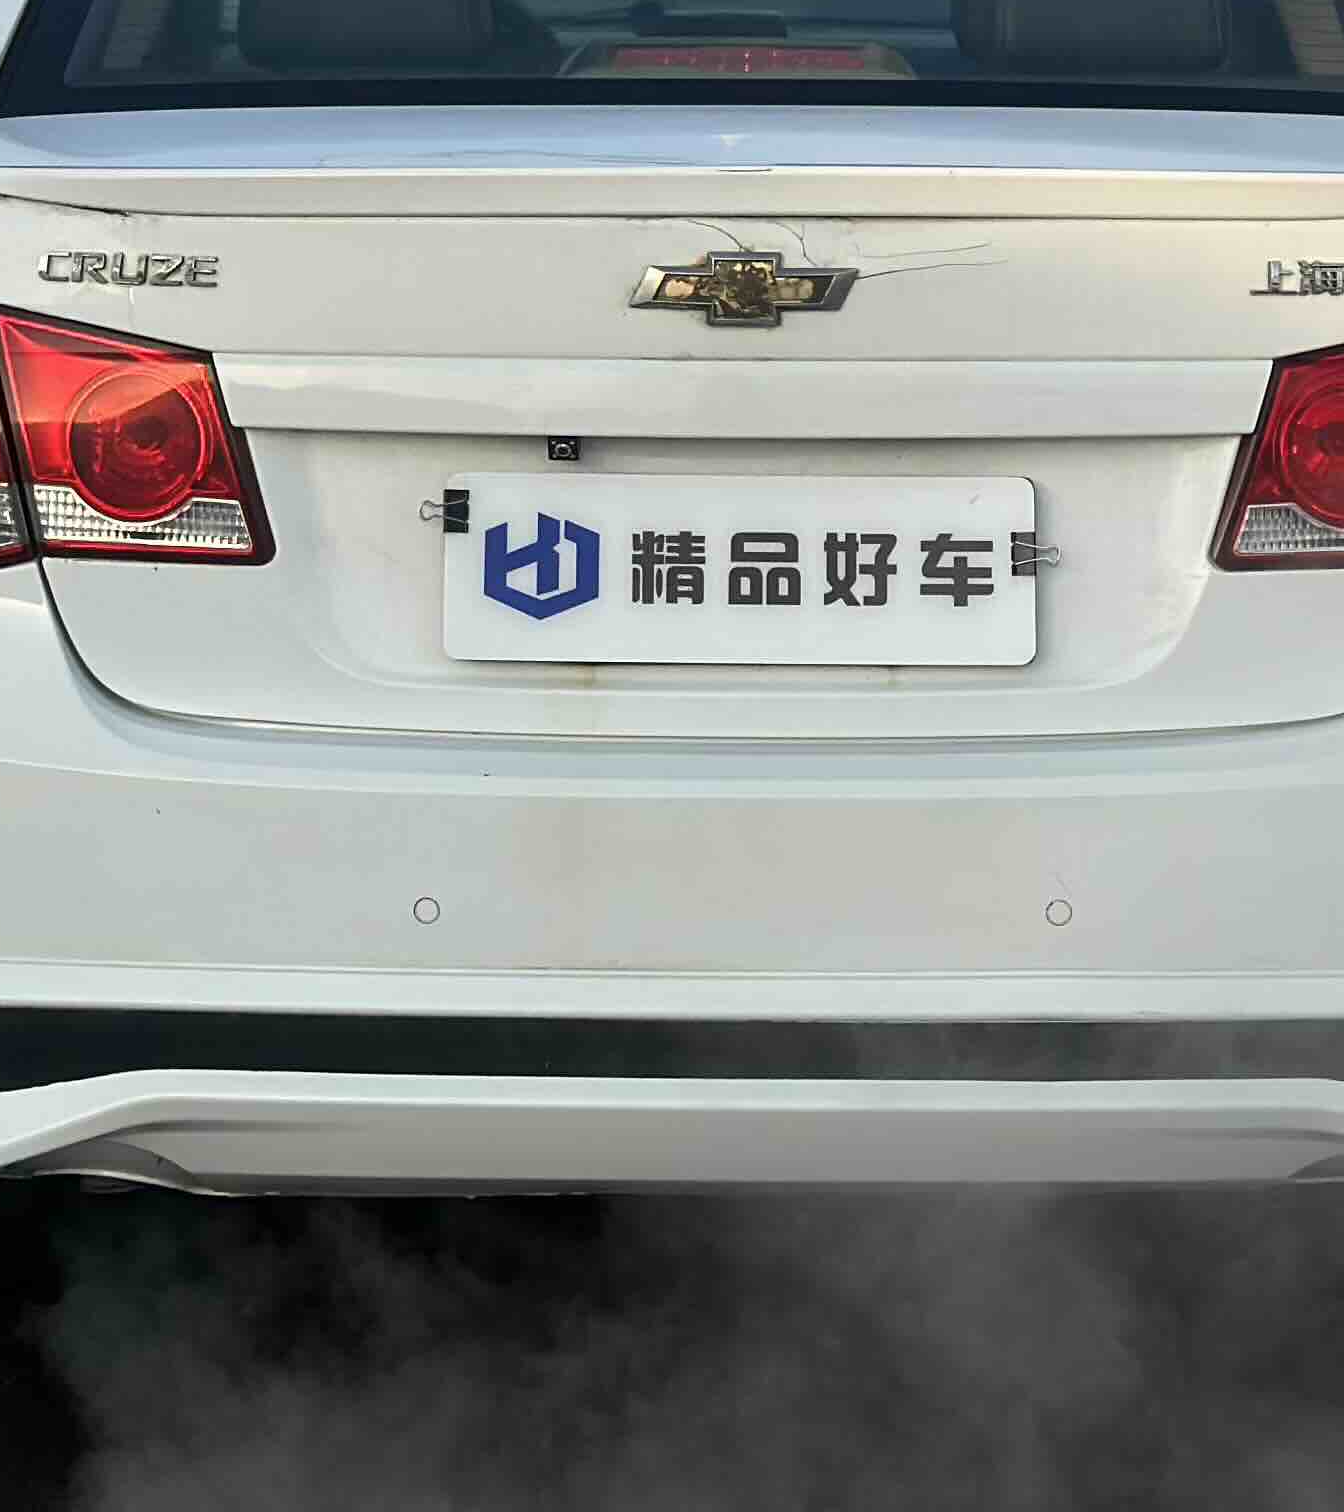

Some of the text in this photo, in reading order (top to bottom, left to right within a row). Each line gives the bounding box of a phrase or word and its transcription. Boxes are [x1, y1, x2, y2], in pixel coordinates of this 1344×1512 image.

[38, 251, 219, 287] CRUZE
[631, 530, 995, 608] 精品好车
